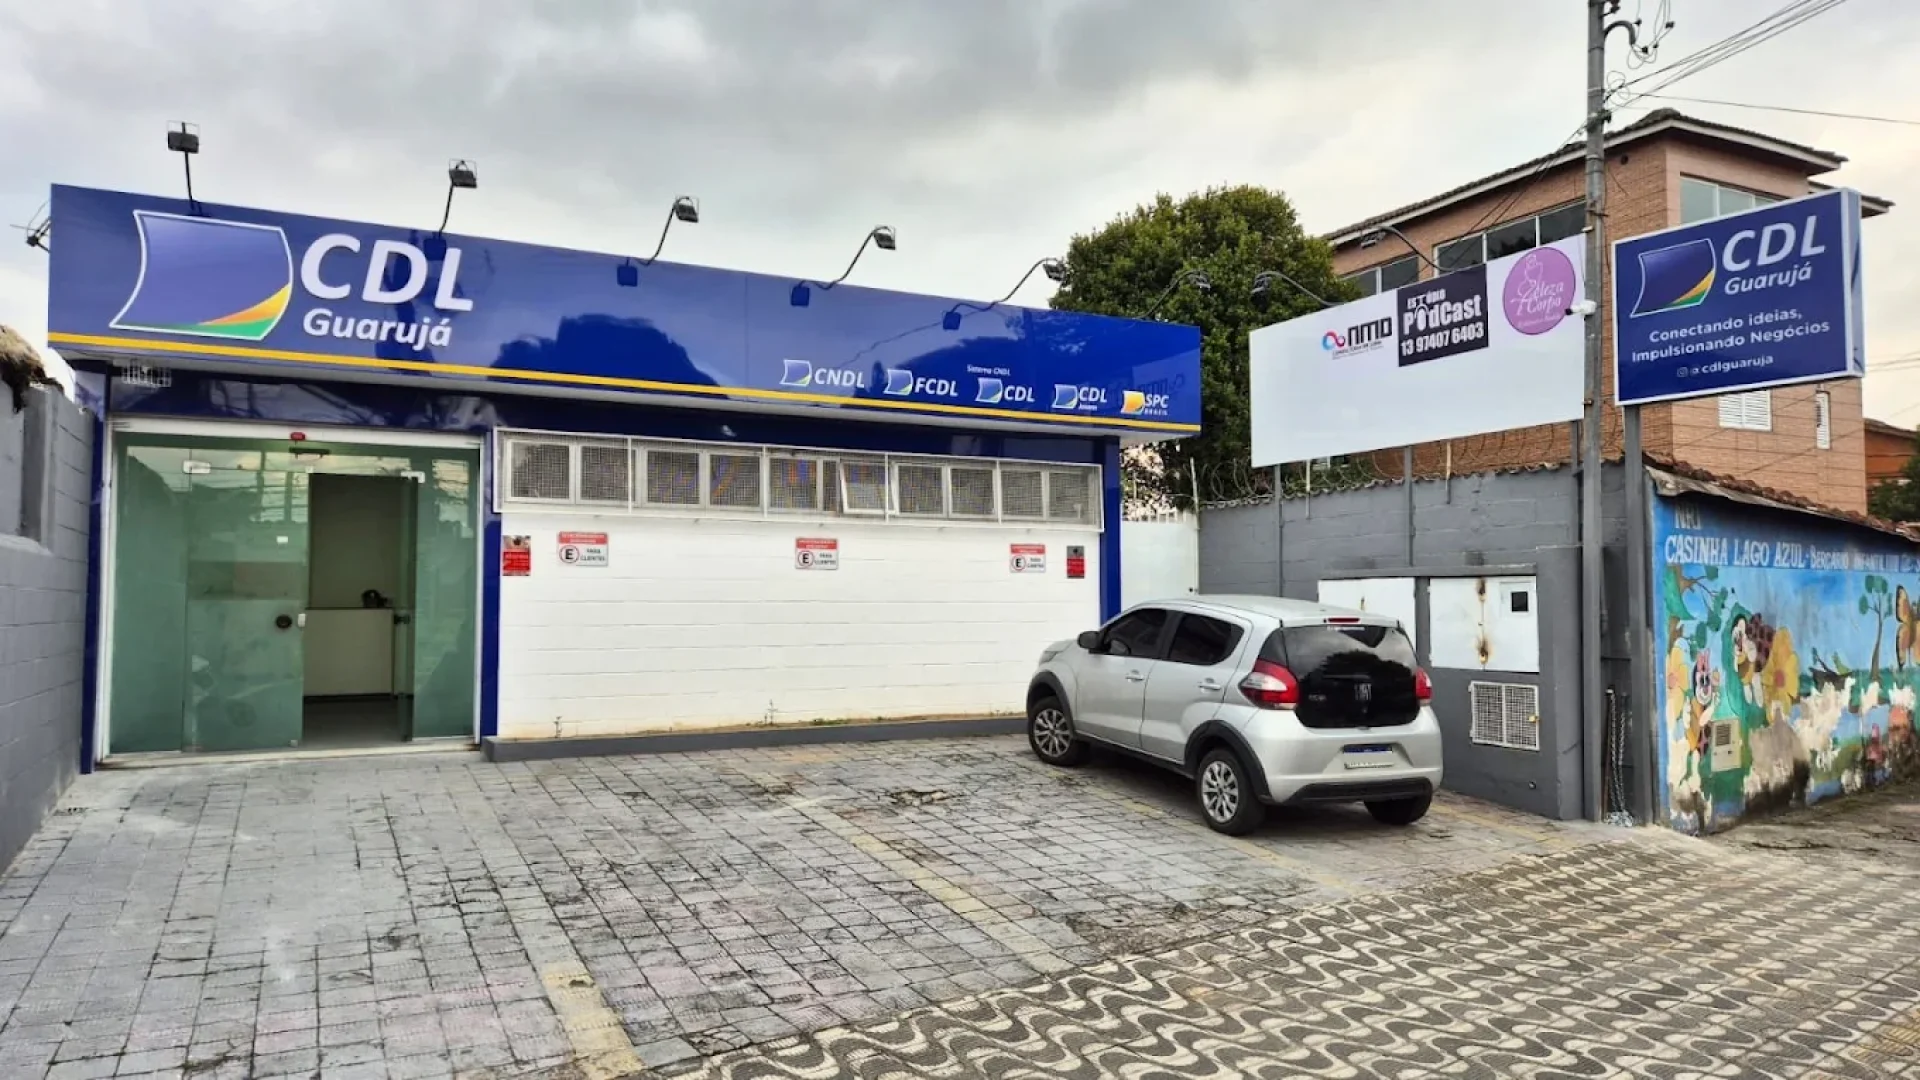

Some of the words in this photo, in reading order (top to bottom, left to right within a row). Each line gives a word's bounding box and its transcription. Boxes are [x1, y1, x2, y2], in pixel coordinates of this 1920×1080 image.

[1722, 216, 1826, 272] CDL
[300, 233, 474, 312] CDL
[1724, 261, 1813, 295] Guarujá
[303, 307, 452, 351] Guarujá
[1401, 338, 1415, 357] 13
[1415, 329, 1451, 353] 97407
[1451, 321, 1485, 345] 6403
[1631, 335, 1746, 363] Impulsionando
[1749, 320, 1831, 344] Negócios
[1649, 317, 1745, 343] Conectando
[1748, 308, 1803, 327] ideias,
[814, 368, 866, 388] CNDL
[914, 377, 959, 398] FCDL
[1003, 384, 1036, 403] CDL
[1079, 386, 1108, 403] CDL
[1144, 393, 1170, 409] SPC
[565, 548, 574, 560] E
[1665, 534, 1729, 566] CASINHA
[1733, 538, 1770, 567] LAGO
[1773, 541, 1805, 569] AZUL
